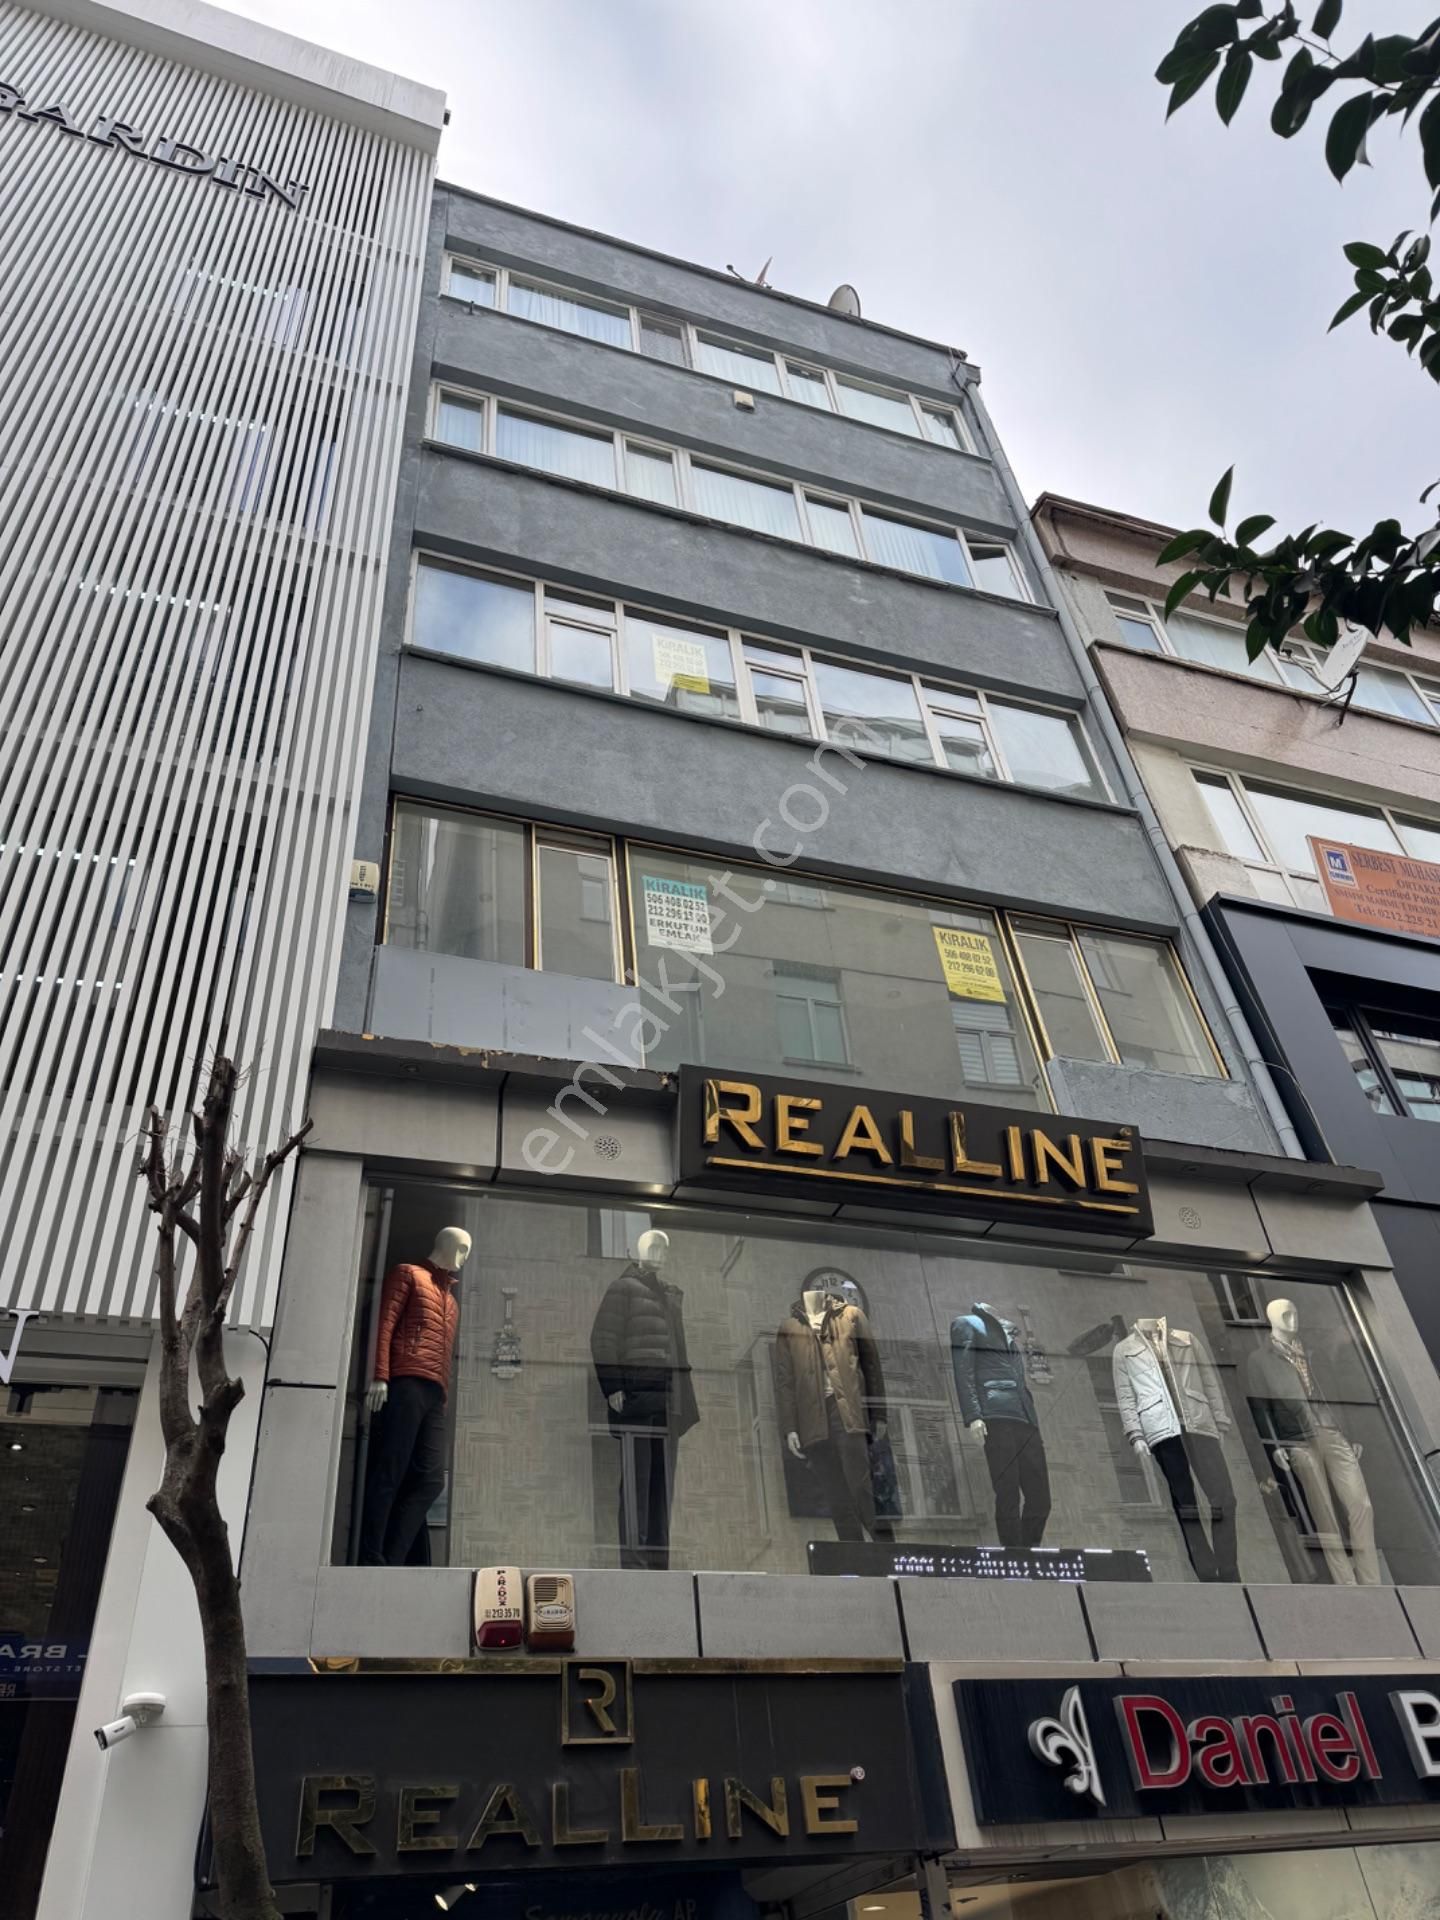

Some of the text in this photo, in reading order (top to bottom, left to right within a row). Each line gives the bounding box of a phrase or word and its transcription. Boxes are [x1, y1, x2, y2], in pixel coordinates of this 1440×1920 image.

[648, 904, 664, 917] 212
[1366, 884, 1411, 900] Certified
[703, 1078, 1140, 1196] REALLINE
[1113, 1691, 1382, 1790] Daniel
[296, 1768, 859, 1857] REALLINE
